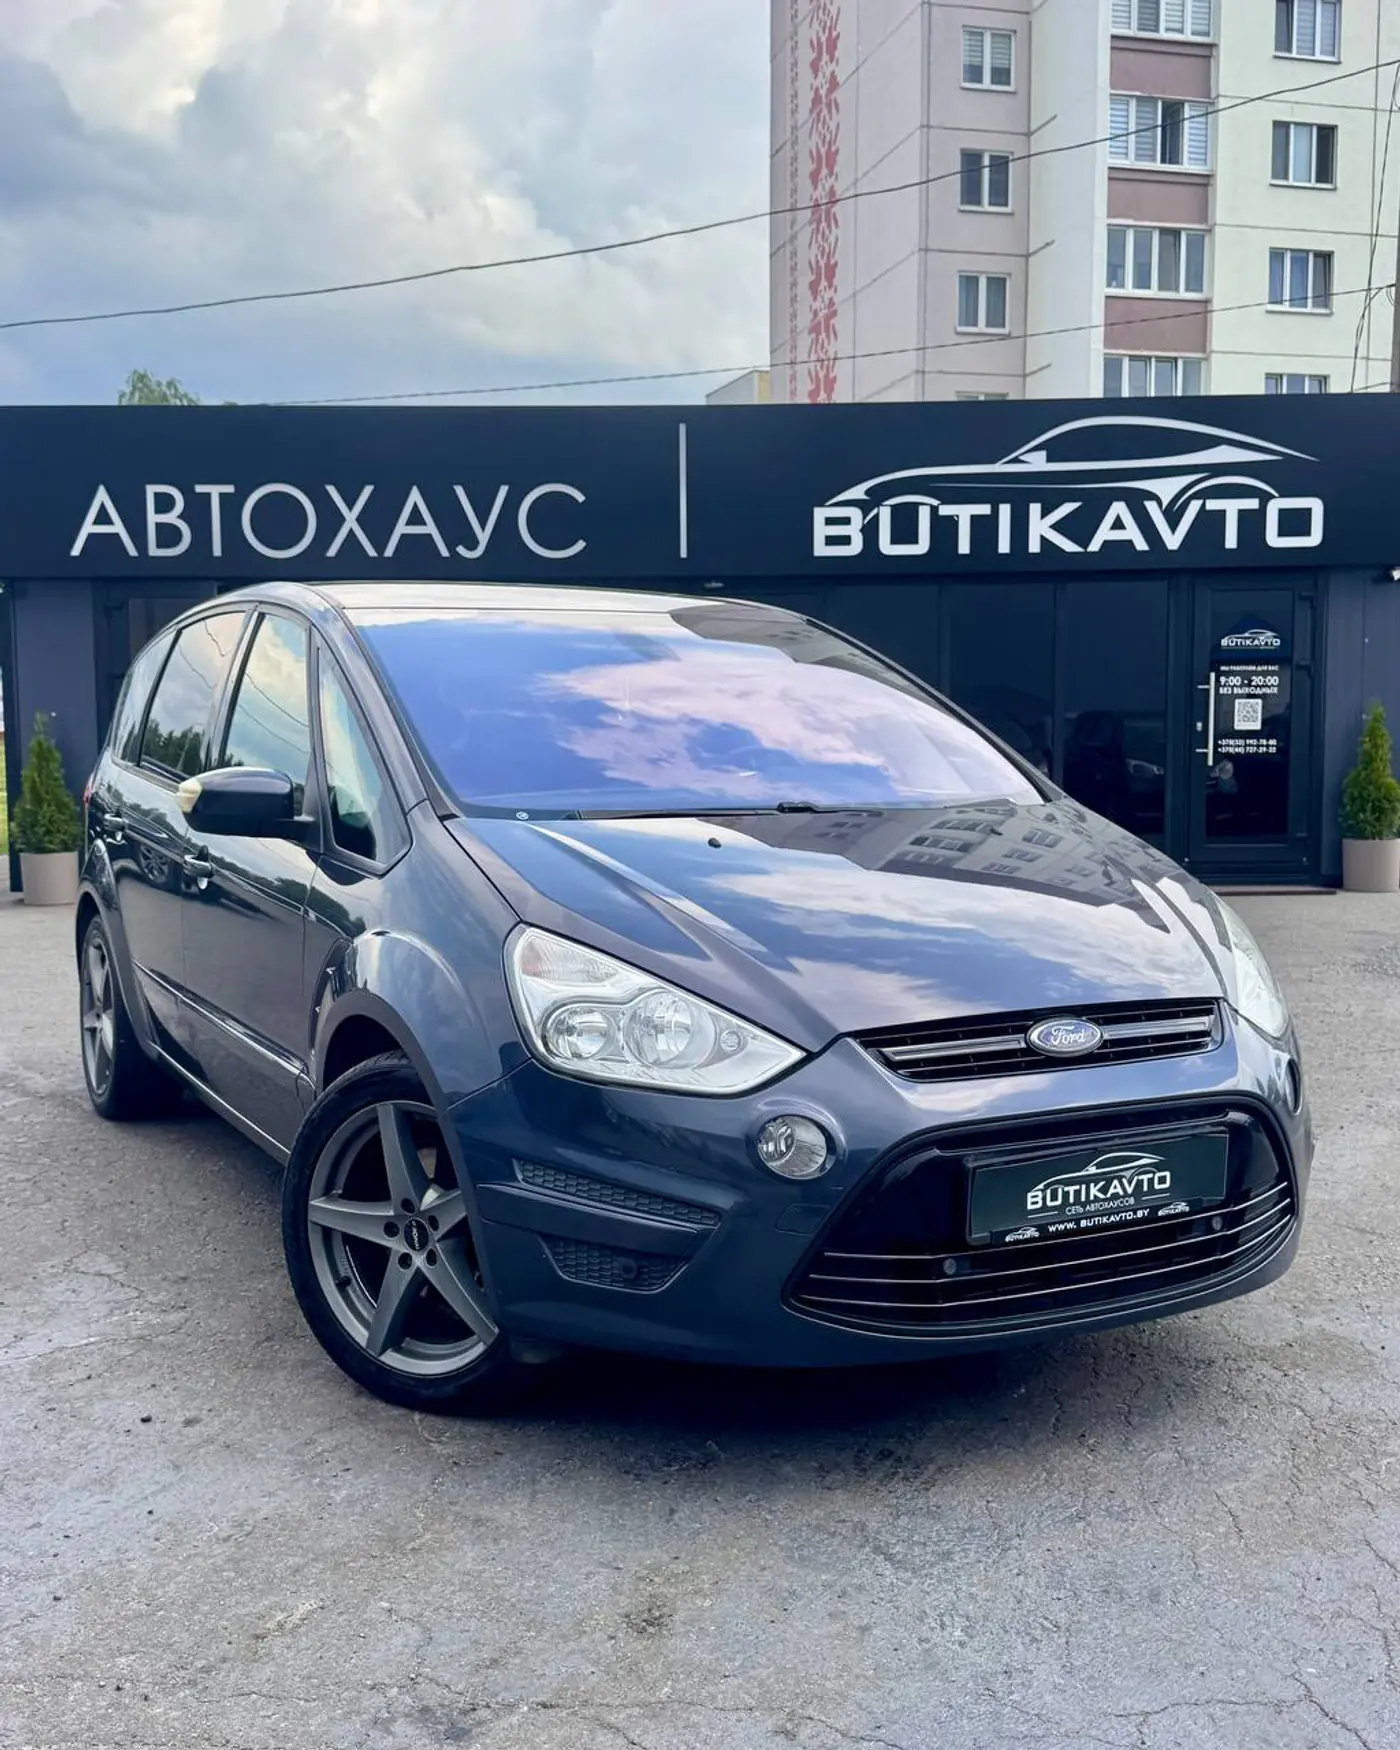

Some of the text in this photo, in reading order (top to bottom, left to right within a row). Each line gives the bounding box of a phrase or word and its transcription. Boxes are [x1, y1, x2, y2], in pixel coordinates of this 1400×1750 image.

[70, 483, 587, 559] АВТОХАУС
[813, 496, 1324, 556] BUTIKAVTO
[1220, 638, 1281, 647] BUTIKAVTO
[1219, 676, 1241, 686] 9:00
[1251, 676, 1279, 686] 20:00
[1233, 687, 1278, 695] ВЫХОДНЫХ
[1051, 1025, 1086, 1045] Ford
[1027, 1171, 1171, 1210] BUTIKAVTO
[1065, 1197, 1134, 1215] СЕТЬ АВТОХАУСОВ
[1048, 1208, 1149, 1232] WWW. BUTIKAVTO.BY
